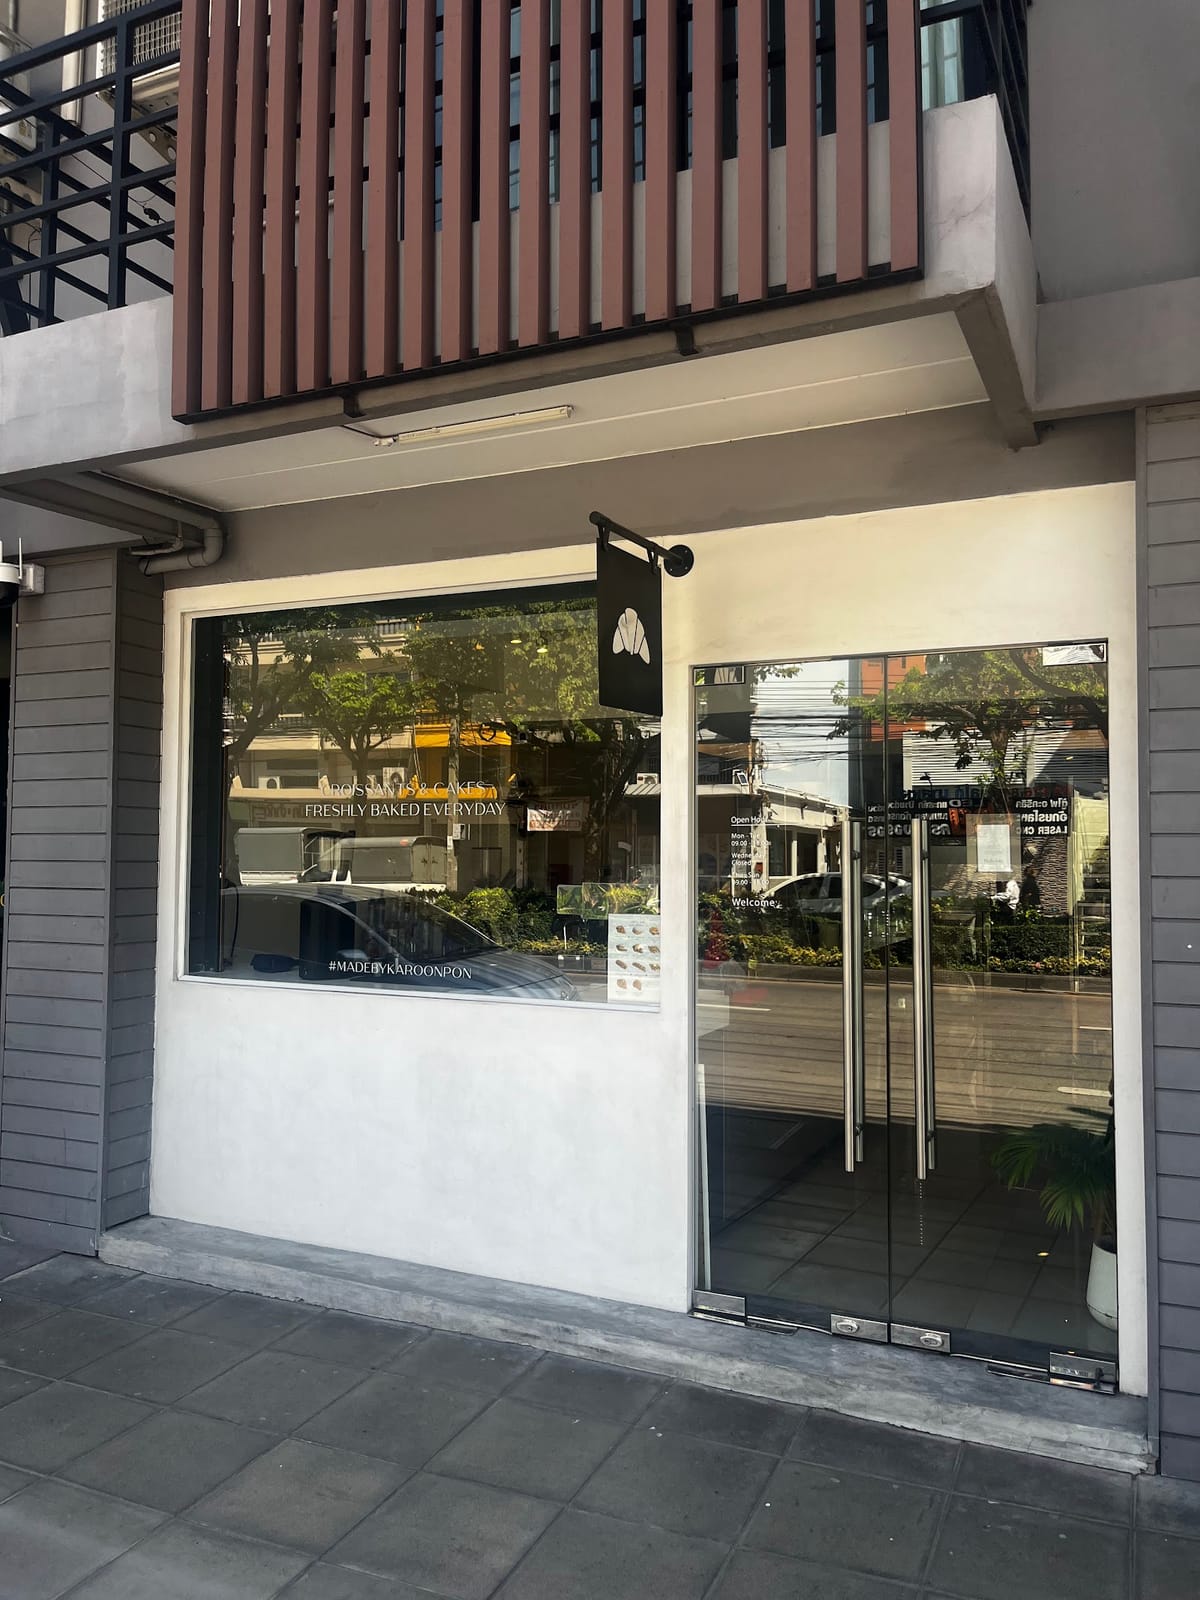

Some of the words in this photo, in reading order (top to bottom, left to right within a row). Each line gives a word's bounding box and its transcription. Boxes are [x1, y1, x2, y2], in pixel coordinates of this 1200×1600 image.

[419, 782, 429, 796] &
[433, 781, 486, 795] CAKES
[305, 803, 368, 817] FRESHLY
[370, 803, 421, 817] BAKED
[423, 802, 506, 816] EVERYDAY
[730, 816, 750, 824] Open
[731, 898, 775, 907] Welcome
[328, 960, 472, 979] #MADEBYKAROONPON
